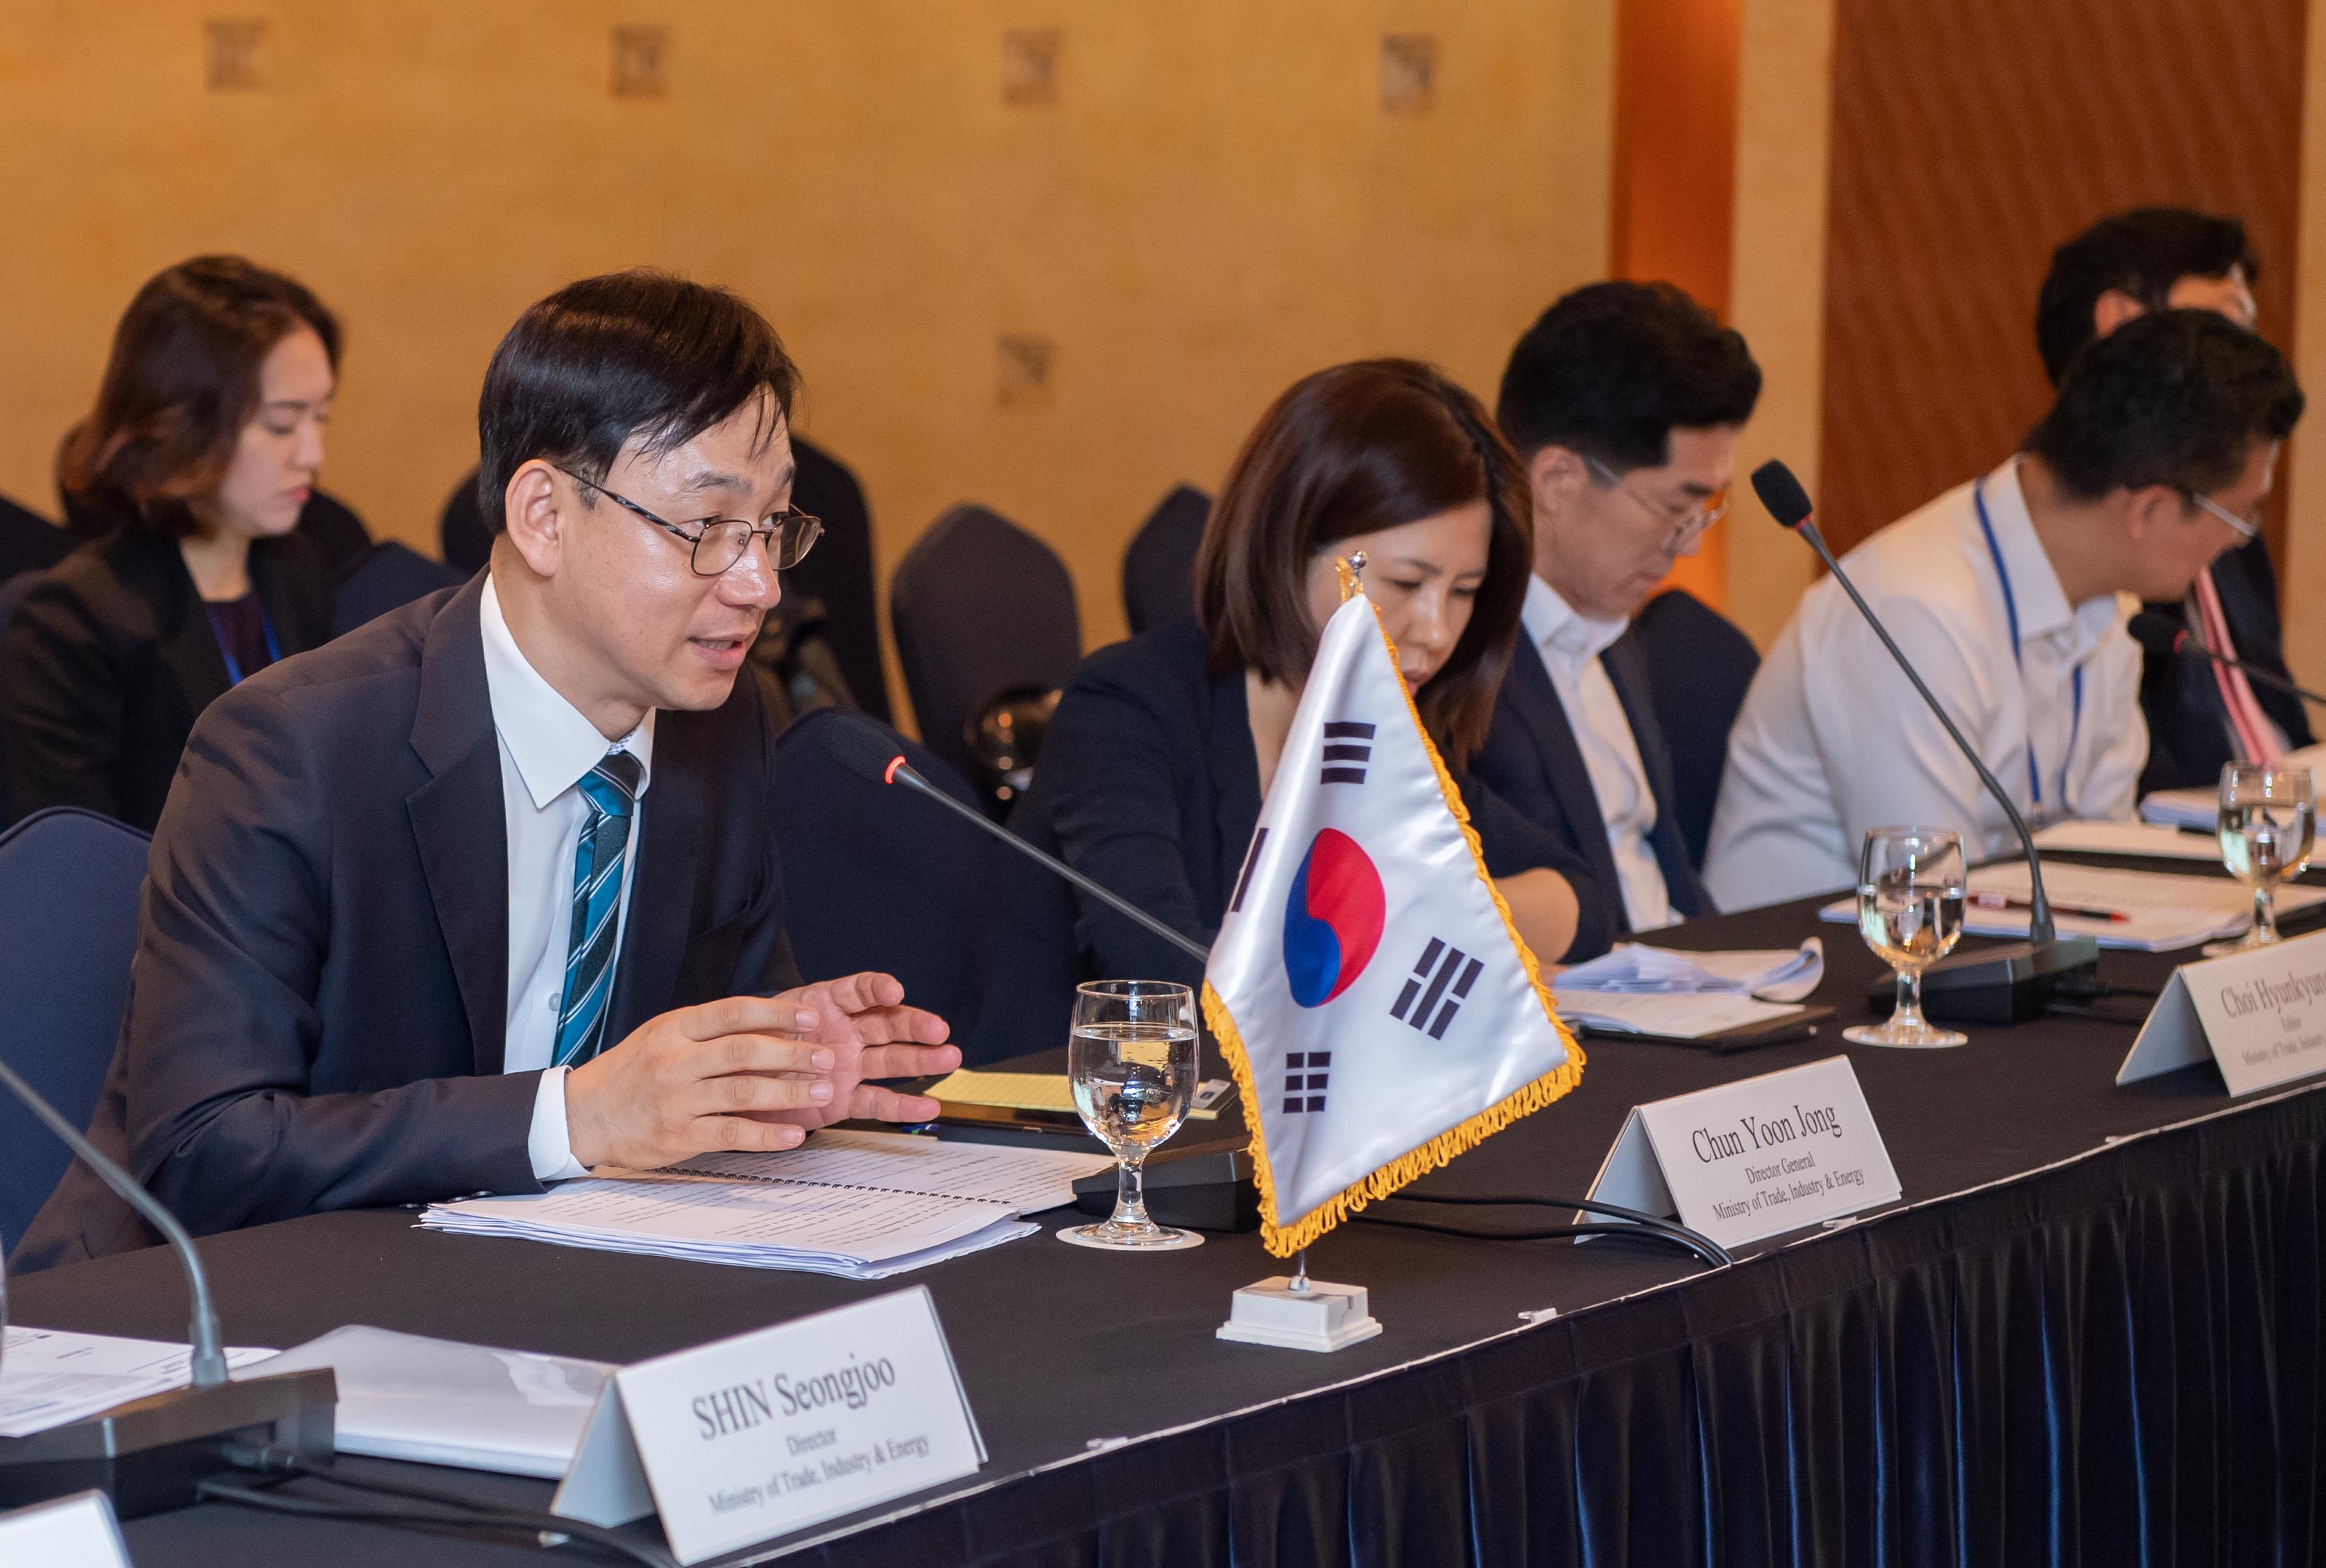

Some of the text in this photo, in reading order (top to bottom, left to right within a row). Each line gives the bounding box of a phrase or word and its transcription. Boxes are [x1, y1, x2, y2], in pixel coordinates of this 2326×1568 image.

[2221, 981, 2259, 1019] Choi
[1692, 1105, 1842, 1164] Chun Yoon Jong
[1744, 1151, 1815, 1184] Director General
[1712, 1168, 1865, 1221] Ministry of Trade, Industry & Energy
[693, 1352, 896, 1441] SHIN Seongjoo
[785, 1429, 838, 1457] Director
[708, 1485, 765, 1515] Ministry
[766, 1472, 782, 1499] of
[820, 1453, 872, 1481] Industry
[873, 1443, 887, 1466] &
[885, 1434, 930, 1460] Energy
